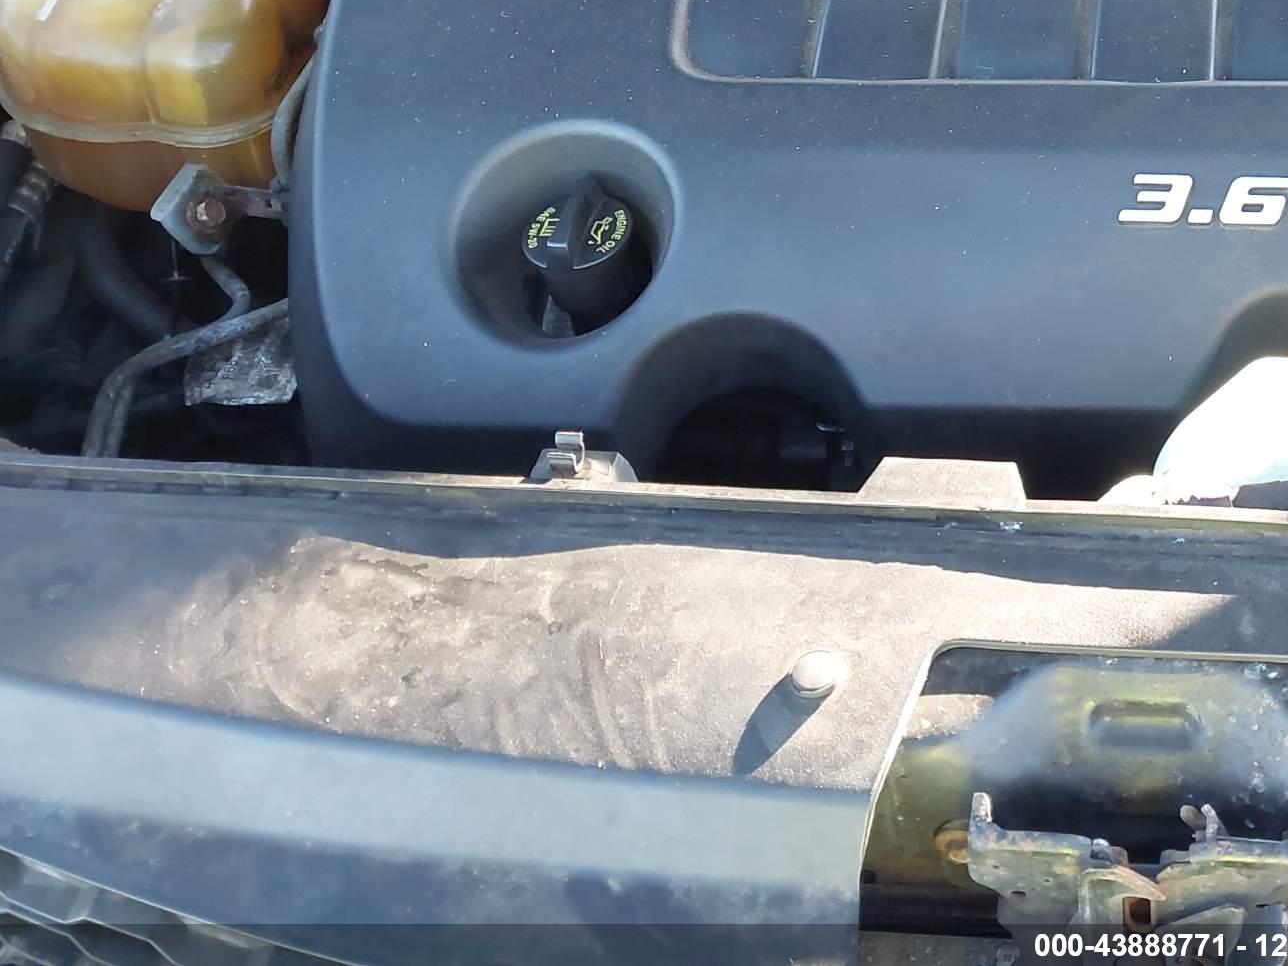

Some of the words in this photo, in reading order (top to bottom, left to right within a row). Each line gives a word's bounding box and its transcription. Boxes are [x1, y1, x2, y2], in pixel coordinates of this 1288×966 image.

[536, 206, 556, 223] SAE
[610, 209, 628, 241] ENGINE
[527, 222, 541, 249] 5W-20
[595, 240, 616, 254] OIL
